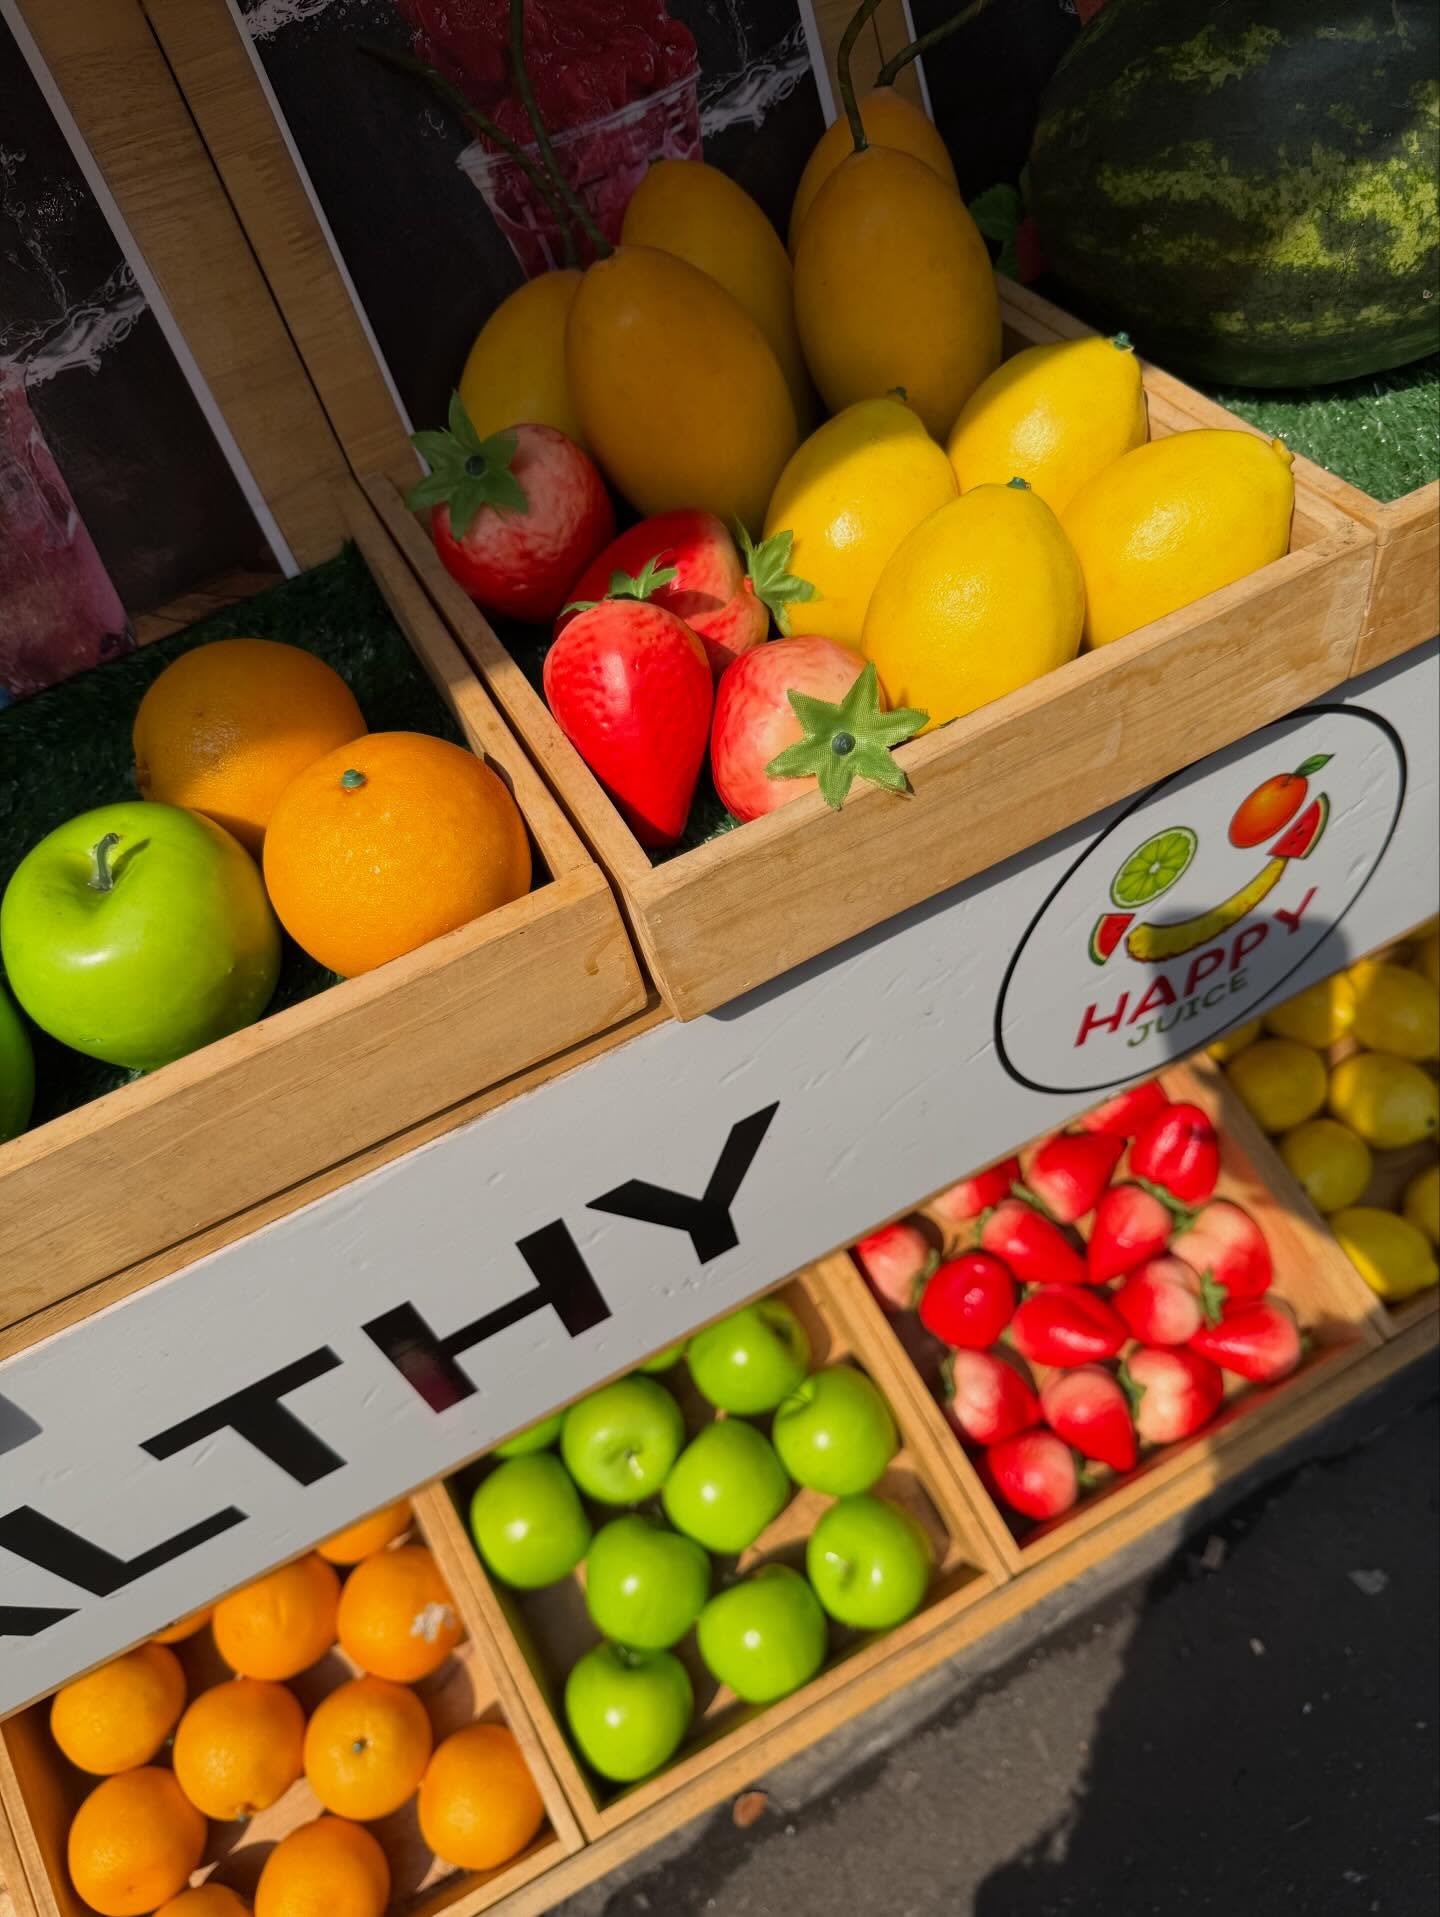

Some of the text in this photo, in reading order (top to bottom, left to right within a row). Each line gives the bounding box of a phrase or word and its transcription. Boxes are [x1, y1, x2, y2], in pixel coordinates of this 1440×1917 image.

[1074, 886, 1318, 1047] HAPPY
[1127, 968, 1248, 1047] JUICE
[0, 1101, 780, 1637] LTHY
